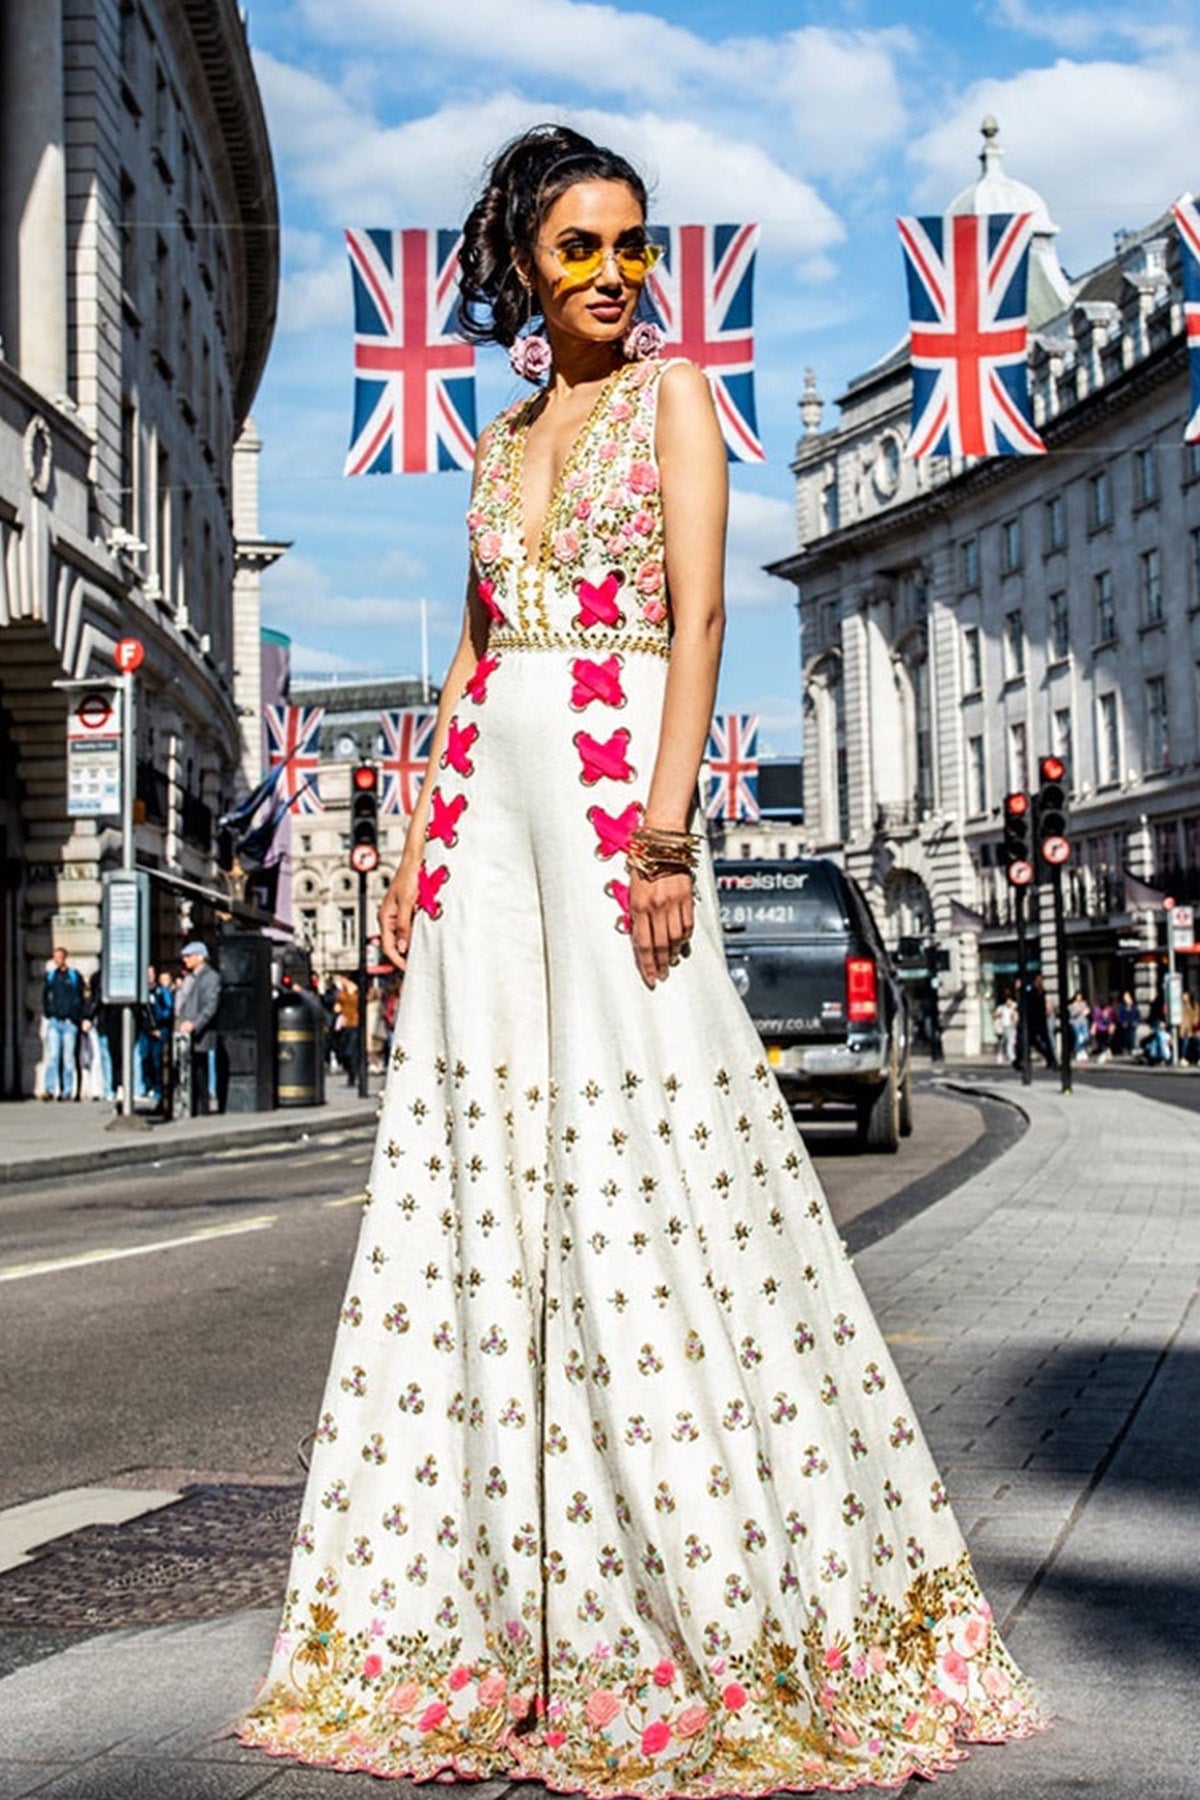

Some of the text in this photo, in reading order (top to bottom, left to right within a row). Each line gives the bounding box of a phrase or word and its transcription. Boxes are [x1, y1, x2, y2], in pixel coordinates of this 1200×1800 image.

[121, 643, 136, 668] F
[717, 872, 809, 890] meister
[754, 1016, 821, 1033] onry.co.uk
